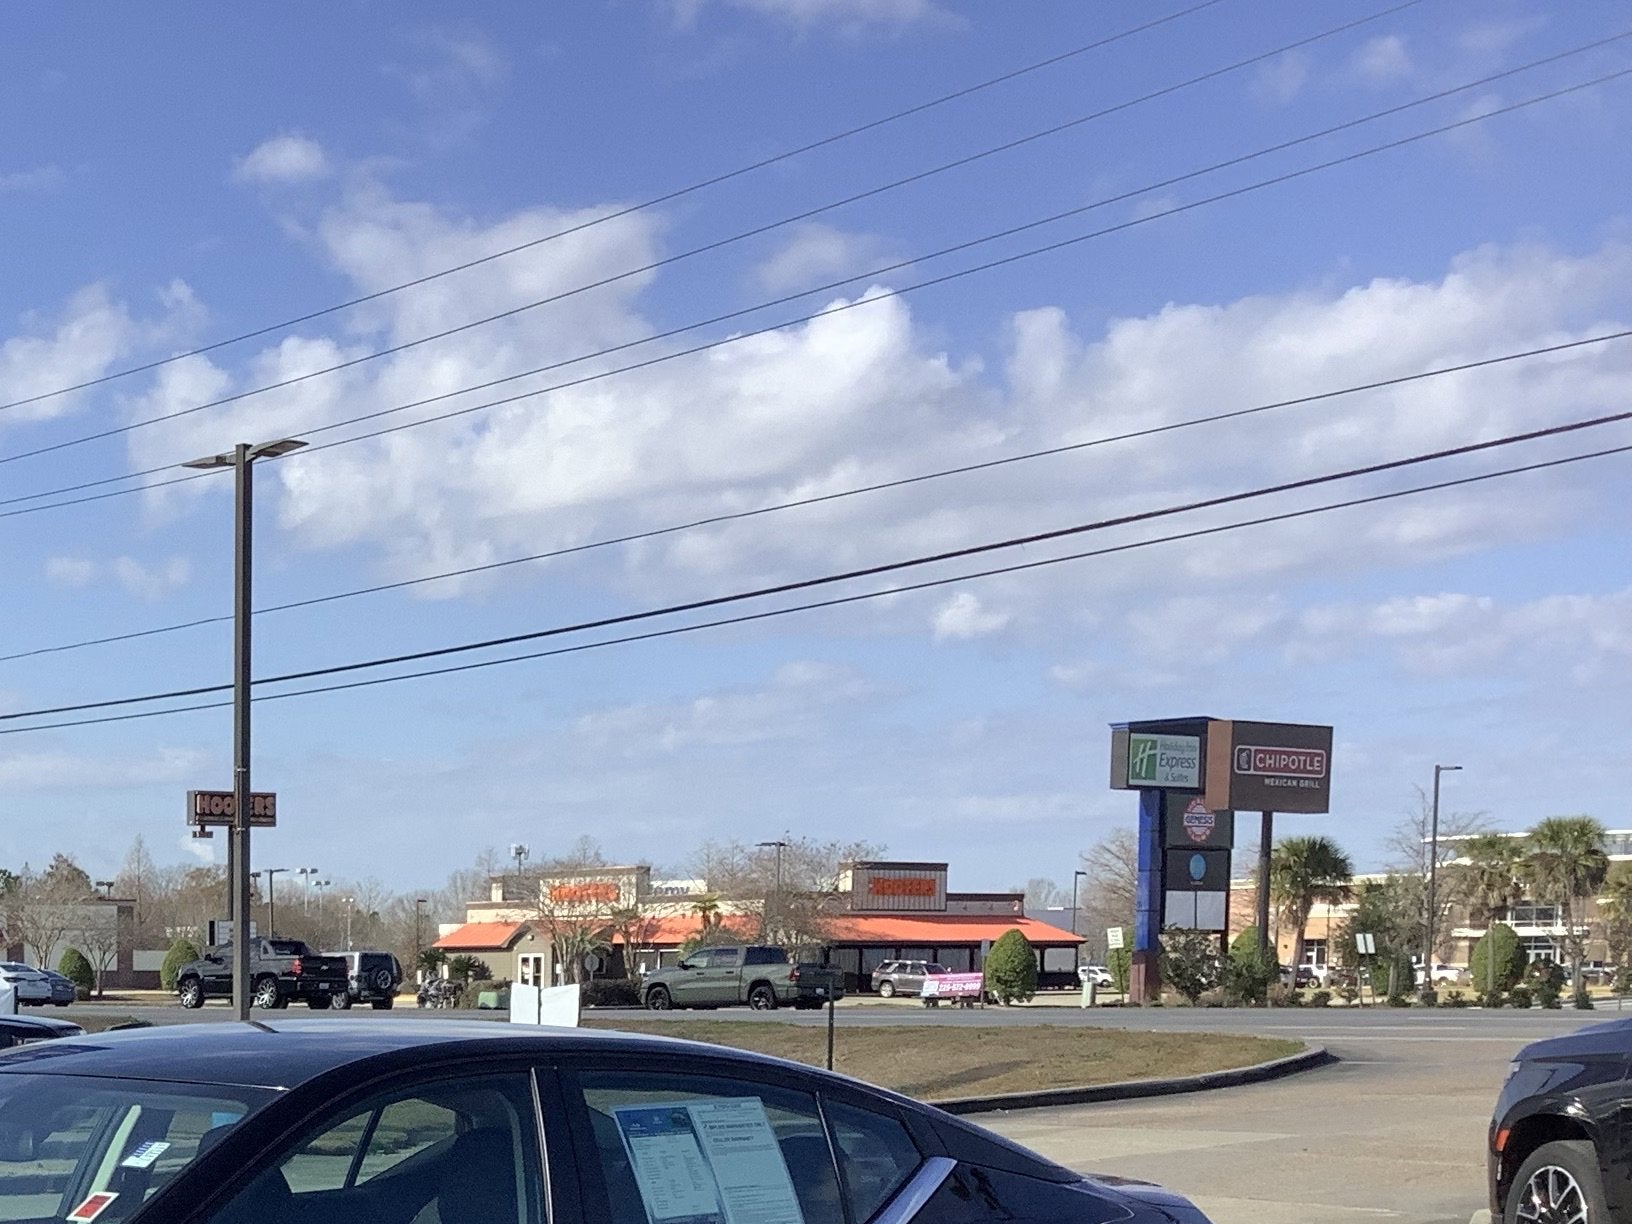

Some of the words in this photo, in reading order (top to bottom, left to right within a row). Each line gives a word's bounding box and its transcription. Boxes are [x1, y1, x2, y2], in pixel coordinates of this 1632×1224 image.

[1159, 752, 1196, 771] Express
[1256, 753, 1321, 770] CHIPOTLE
[1264, 778, 1297, 788] MEXICAN
[1298, 779, 1320, 789] GRILL
[196, 794, 275, 816] HOORS
[1185, 815, 1213, 825] GENESIS
